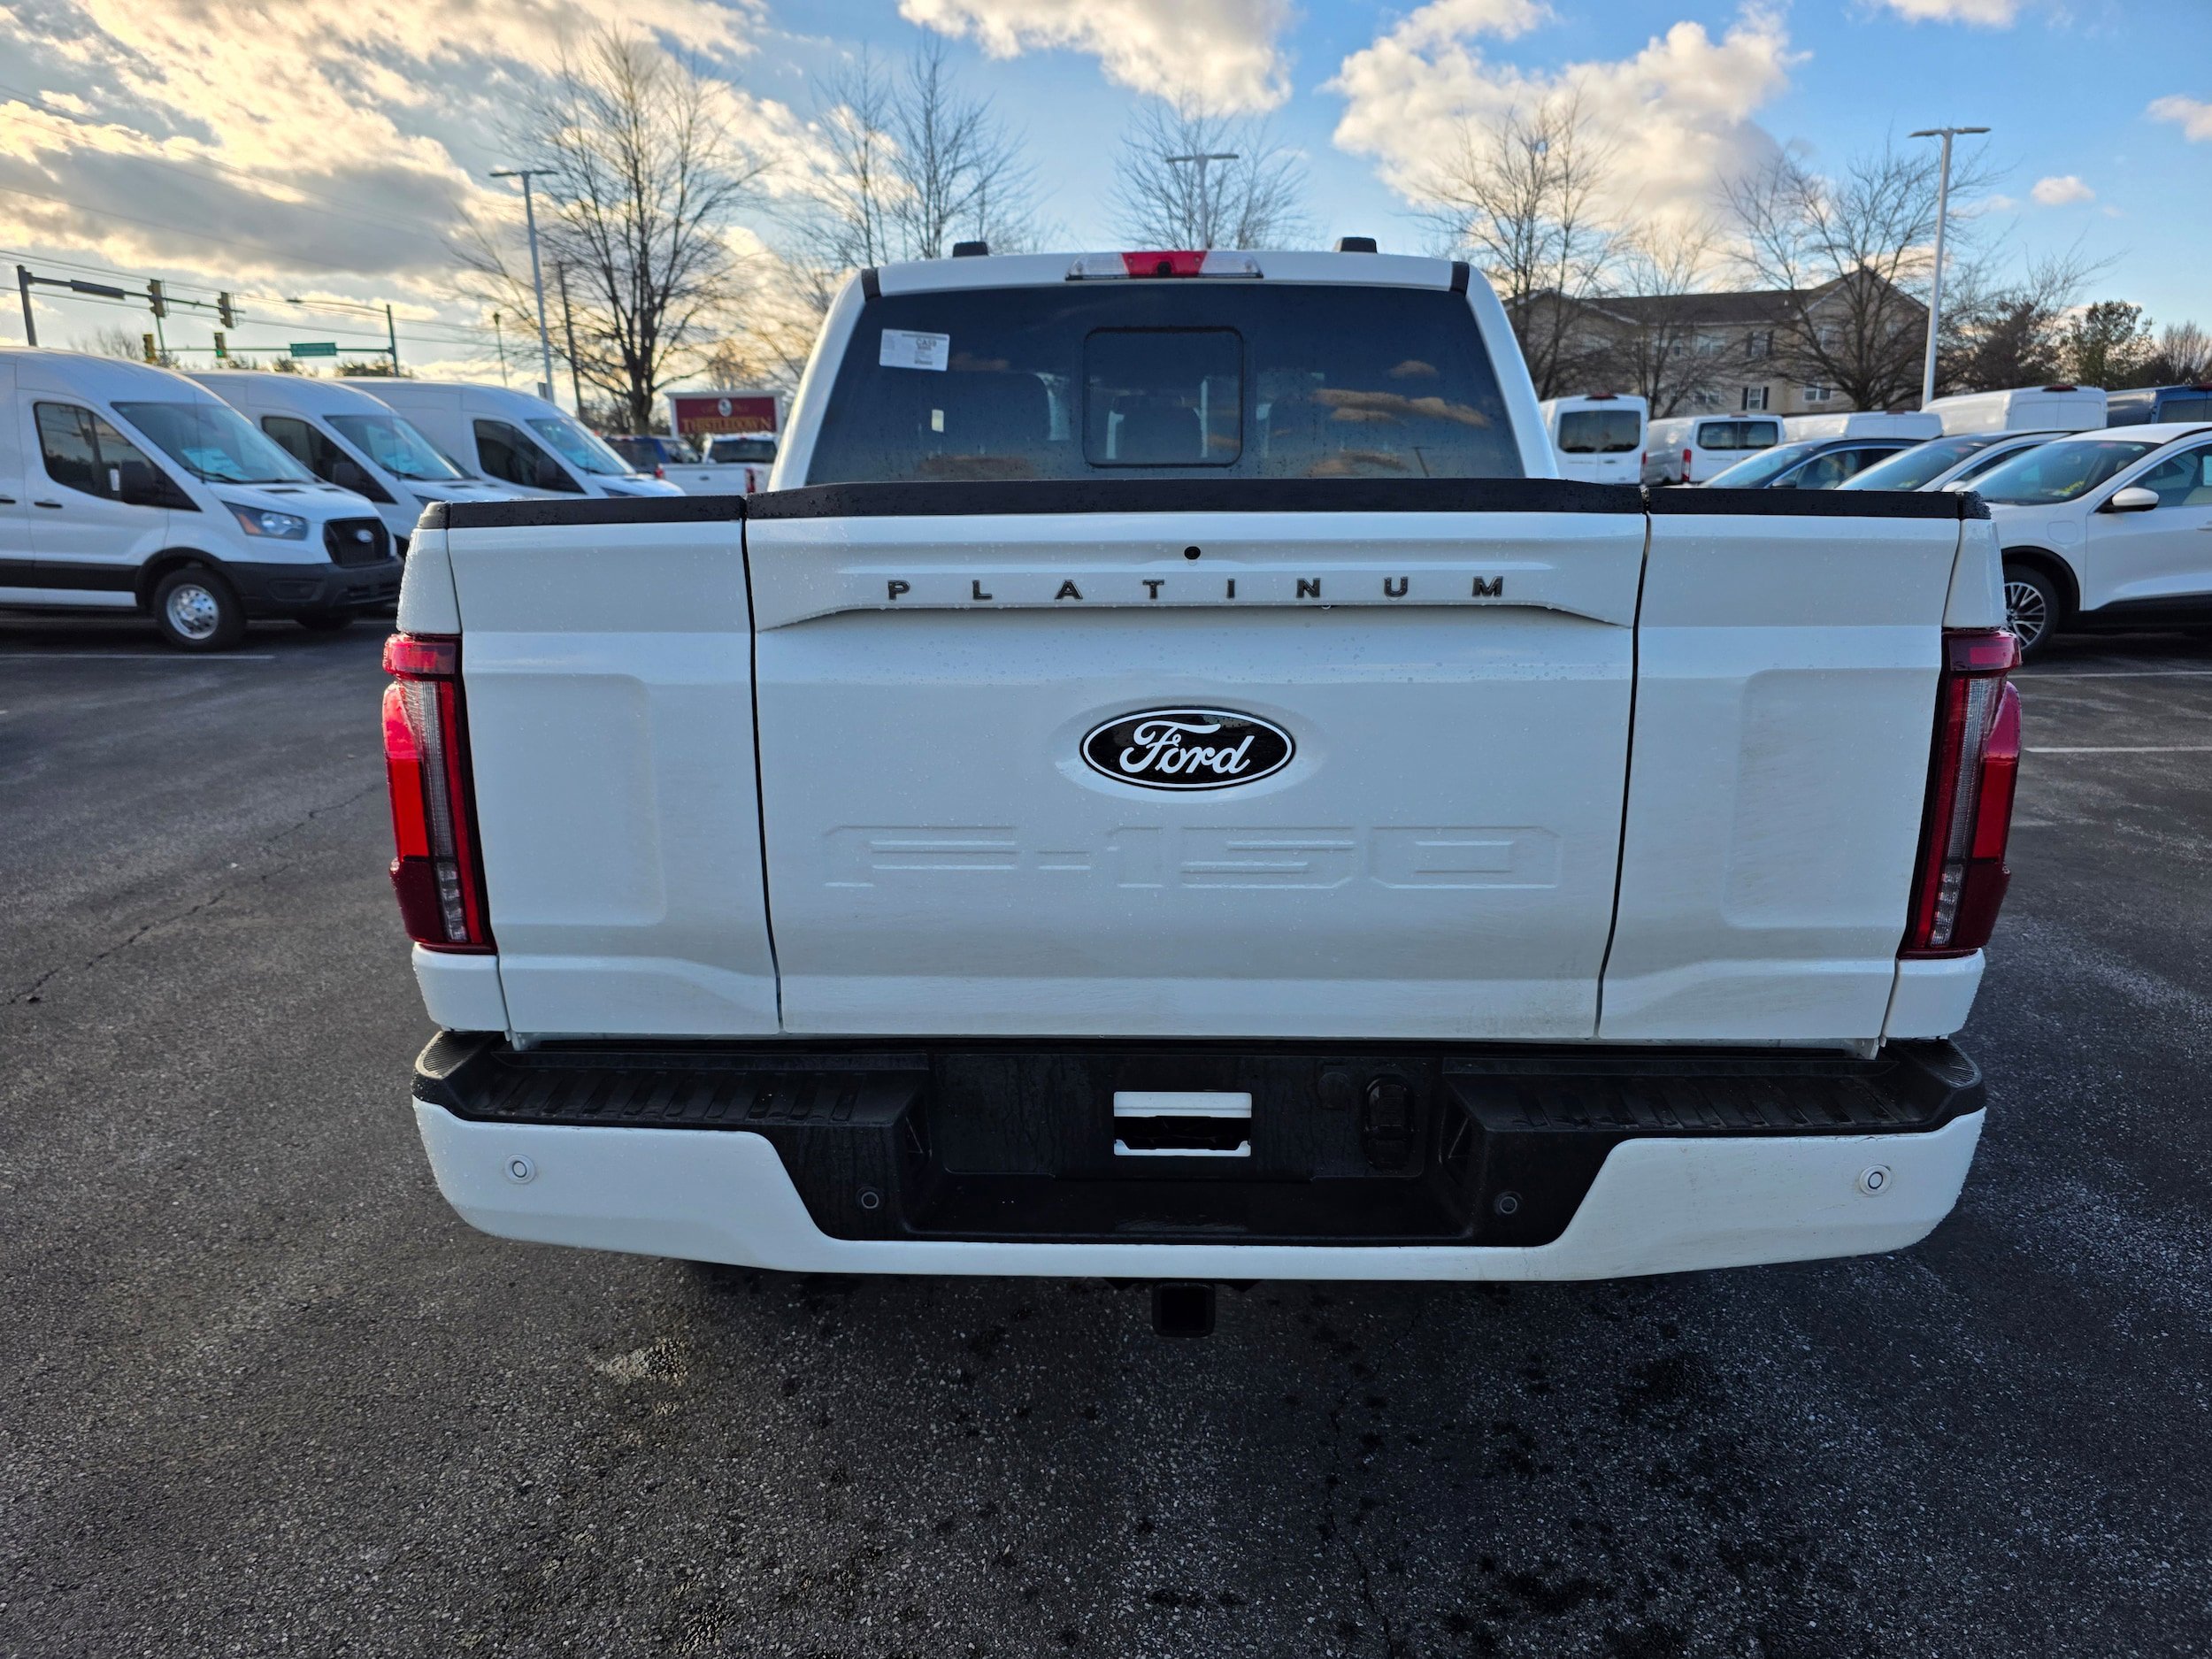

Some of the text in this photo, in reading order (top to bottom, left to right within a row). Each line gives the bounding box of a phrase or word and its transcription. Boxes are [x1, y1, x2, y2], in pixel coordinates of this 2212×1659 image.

[887, 575, 1505, 601] PLATINUM
[1118, 719, 1256, 774] Ford
[823, 824, 1563, 889] F-150
